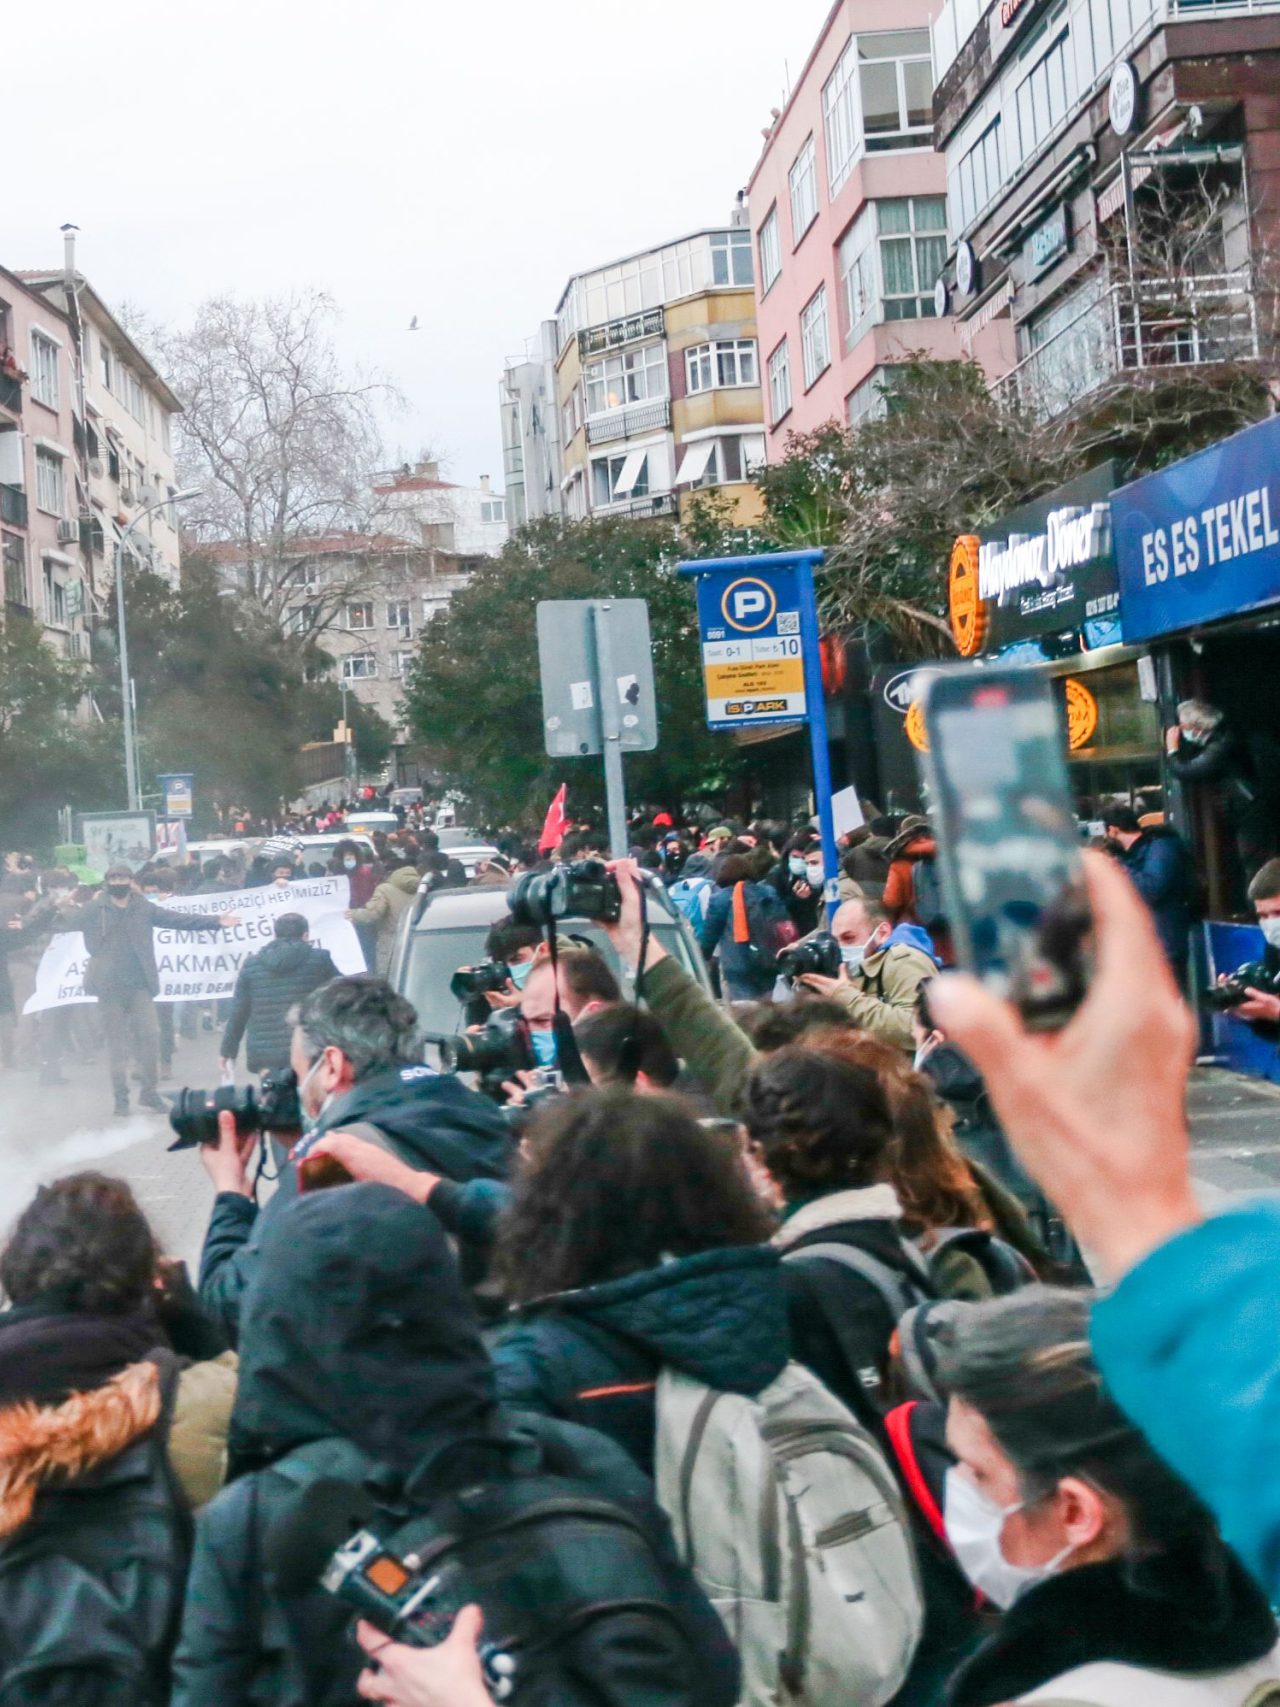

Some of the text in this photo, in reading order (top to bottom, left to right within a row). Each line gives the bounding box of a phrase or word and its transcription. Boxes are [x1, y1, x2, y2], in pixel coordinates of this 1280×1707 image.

[1142, 486, 1279, 586] ES ES TEKEL
[734, 591, 765, 618] P
[212, 892, 266, 913] BOĞAZİÇİ
[206, 980, 234, 993] DEM
